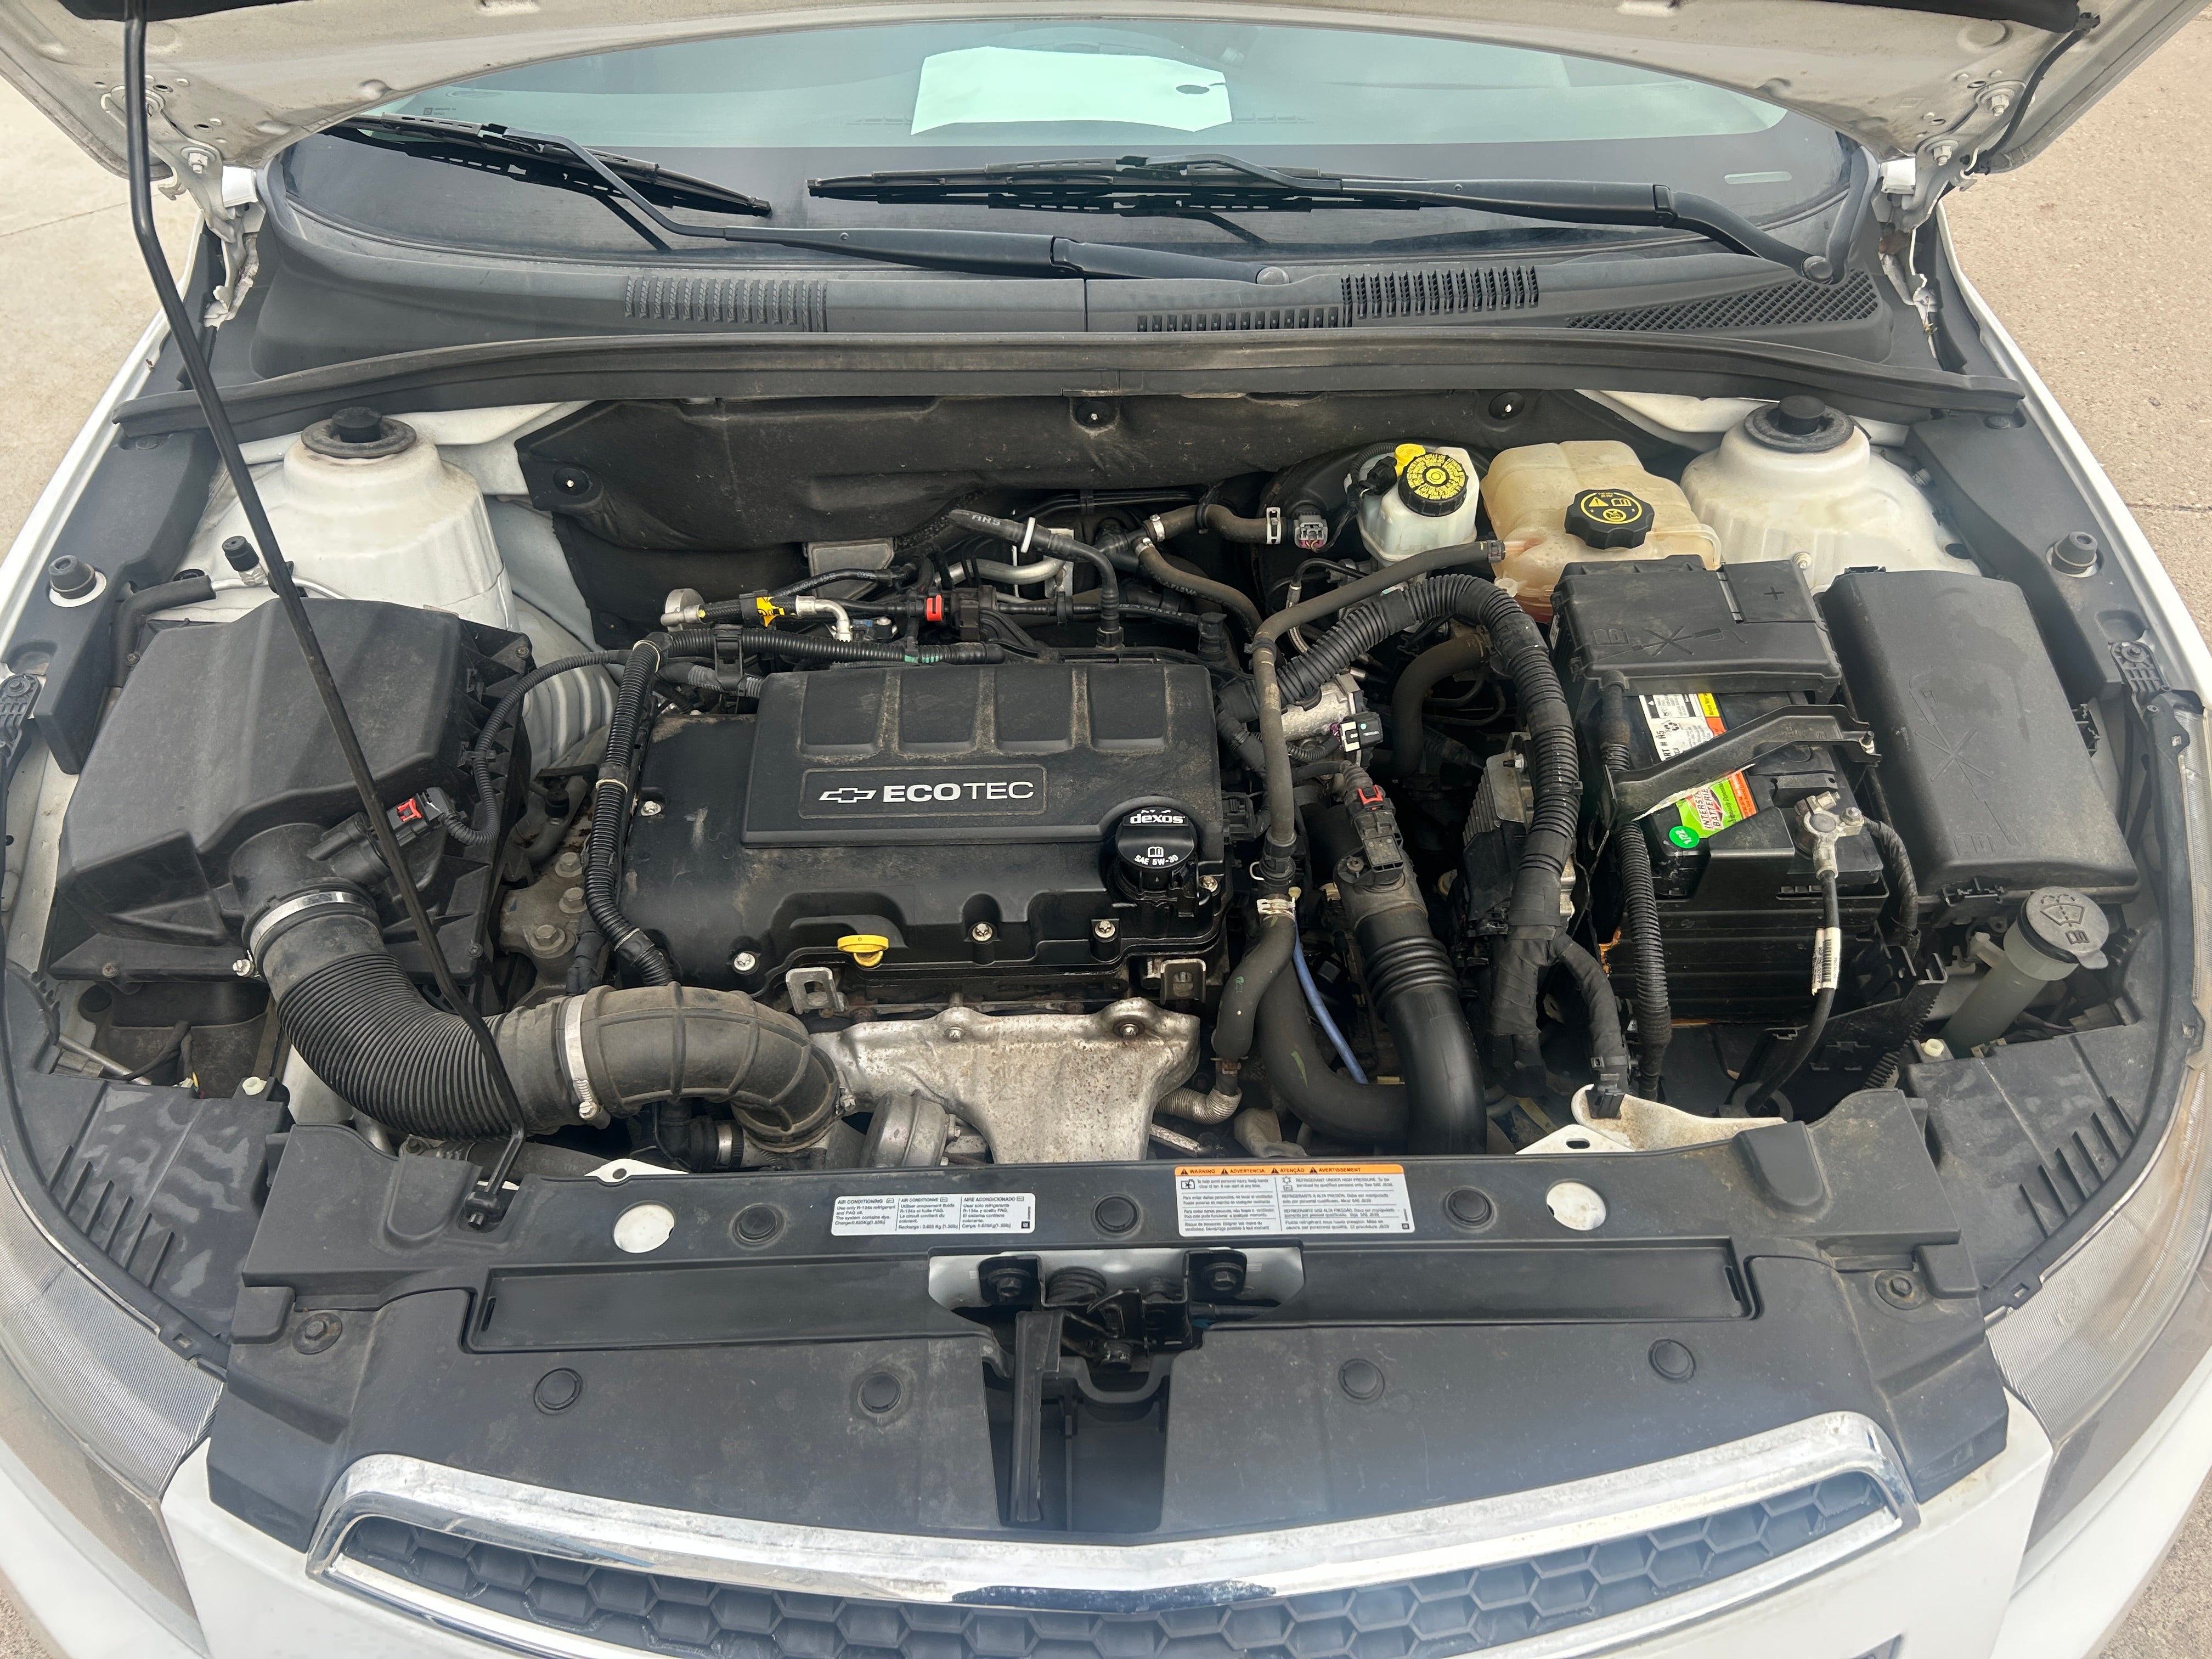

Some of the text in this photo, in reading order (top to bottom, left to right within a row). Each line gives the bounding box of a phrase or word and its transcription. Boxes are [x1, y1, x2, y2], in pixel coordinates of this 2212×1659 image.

[883, 781, 1034, 803] ECOTEC
[1130, 814, 1183, 824] dexos
[1675, 829, 1692, 845] 1/22
[1134, 854, 1179, 866] SAE 5W-30
